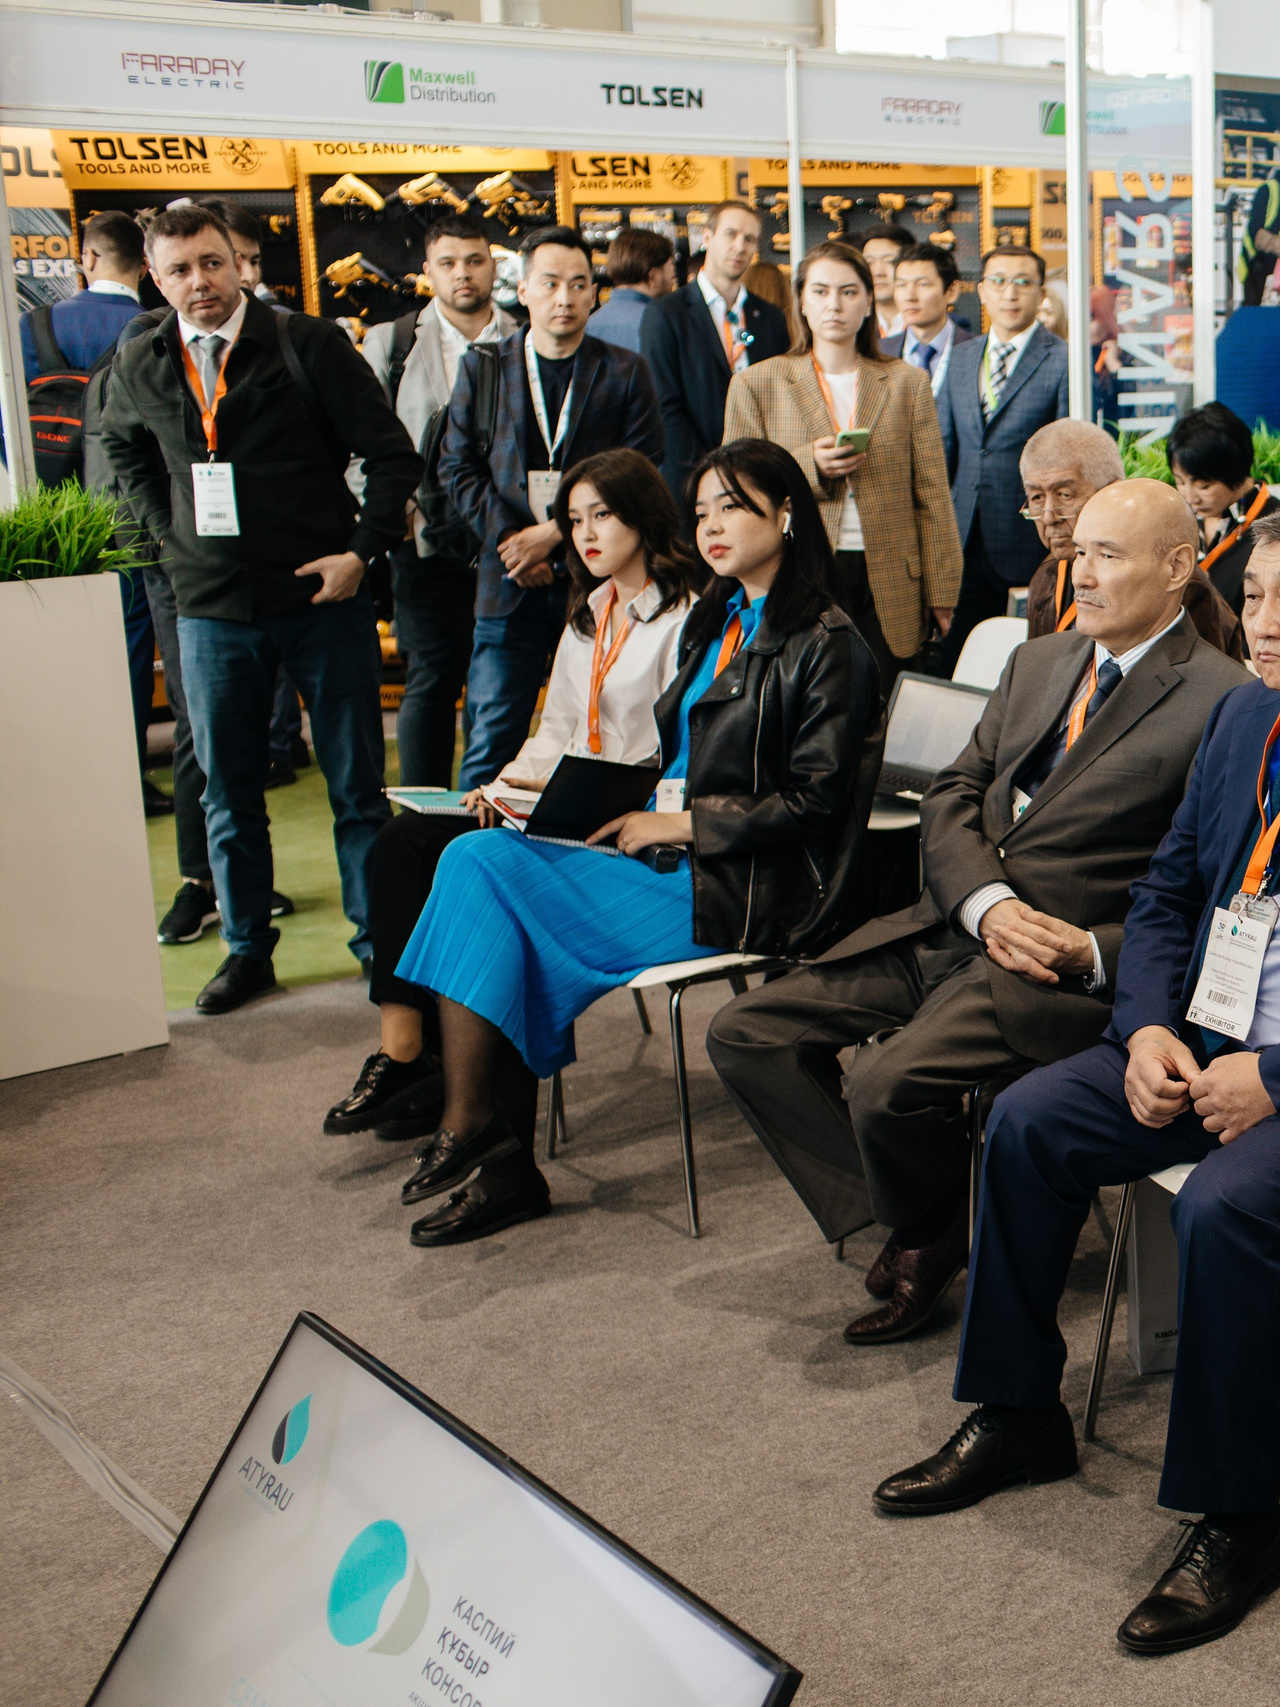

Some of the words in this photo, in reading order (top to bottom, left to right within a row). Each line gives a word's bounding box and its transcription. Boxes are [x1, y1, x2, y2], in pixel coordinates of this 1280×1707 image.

[121, 52, 245, 76] FARADAY
[128, 75, 245, 90] ELECTRIC
[410, 68, 475, 85] Maxwell
[410, 85, 496, 103] Distribution
[600, 83, 703, 109] TOLSEN
[68, 137, 208, 160] TOLSEN
[313, 143, 367, 155] TOOLS
[372, 143, 408, 155] AND
[76, 163, 126, 174] TOOLS
[130, 163, 162, 174] AND
[166, 162, 212, 174] MORE
[579, 179, 608, 190] AND
[612, 178, 653, 190] MORE
[1205, 1015, 1235, 1032] EXHIBITOR
[238, 1456, 294, 1511] ATYRAU
[452, 1595, 516, 1658] КАСПИЙ
[437, 1626, 489, 1678] ҚҰБЫР
